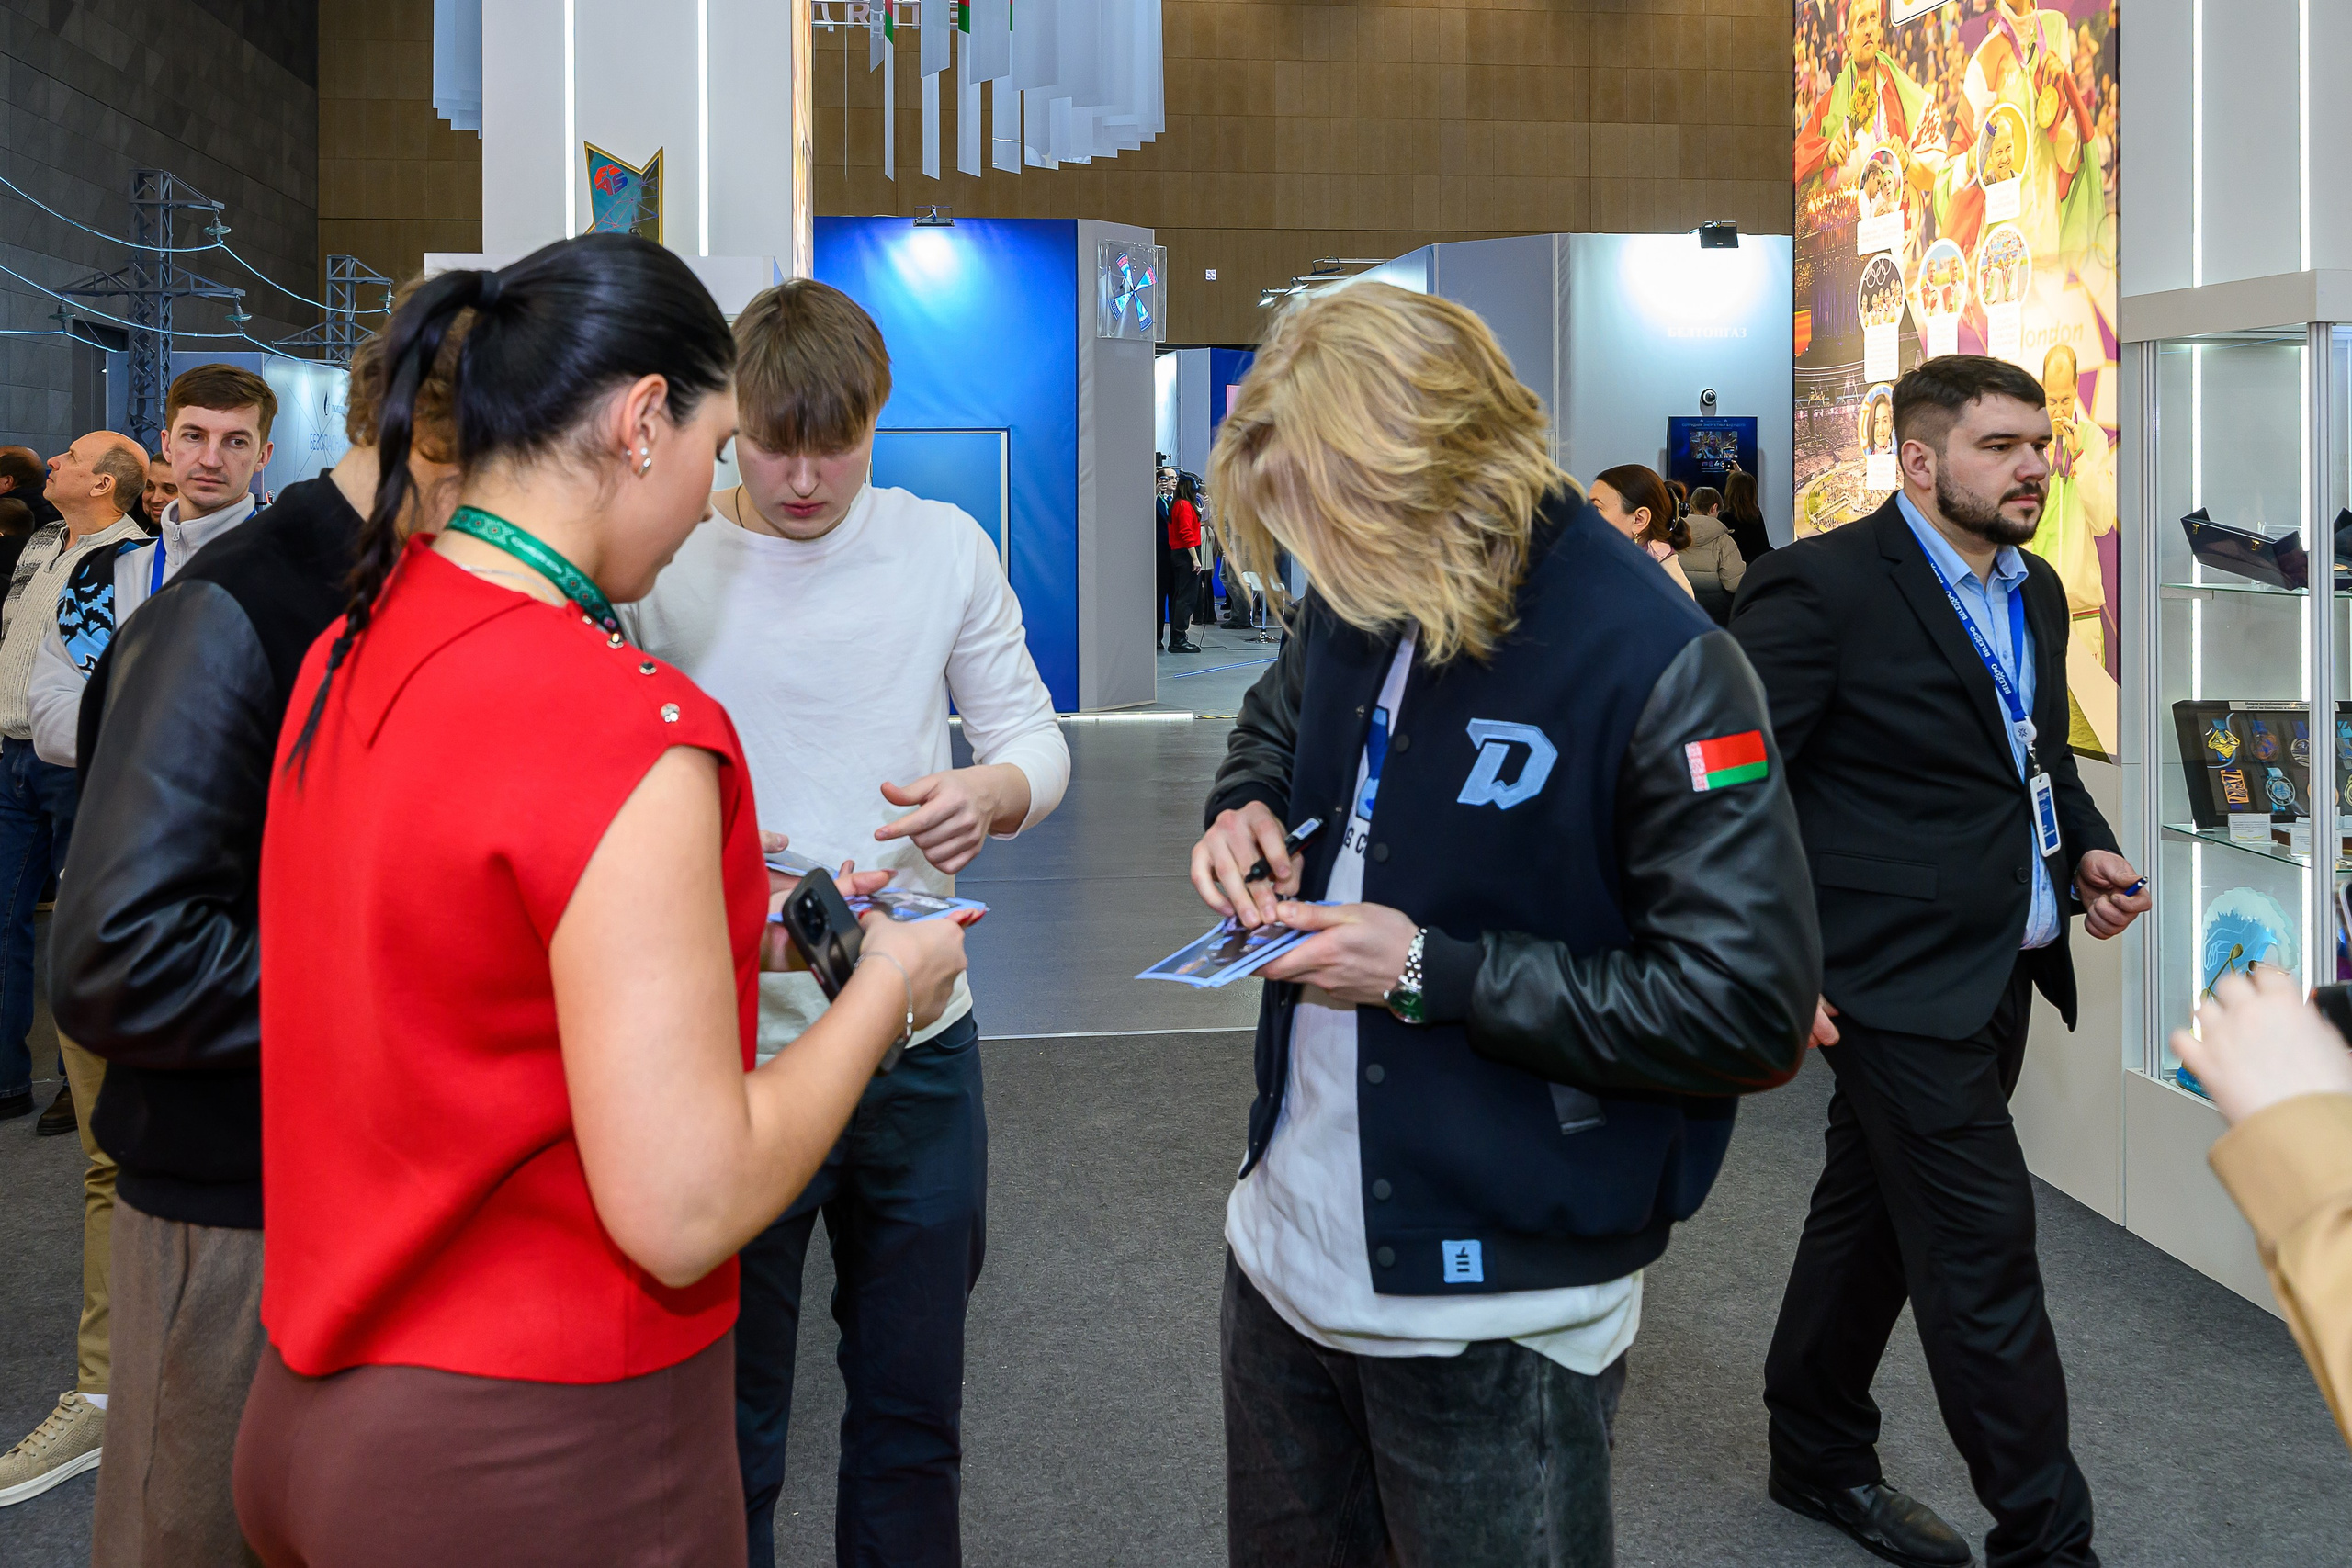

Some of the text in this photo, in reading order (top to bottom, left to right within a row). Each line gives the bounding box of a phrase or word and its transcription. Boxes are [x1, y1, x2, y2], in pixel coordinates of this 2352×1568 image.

[1970, 626, 1992, 658] BELEXPO
[1991, 663, 2012, 695] BELEXPO
[1457, 717, 1558, 810] D
